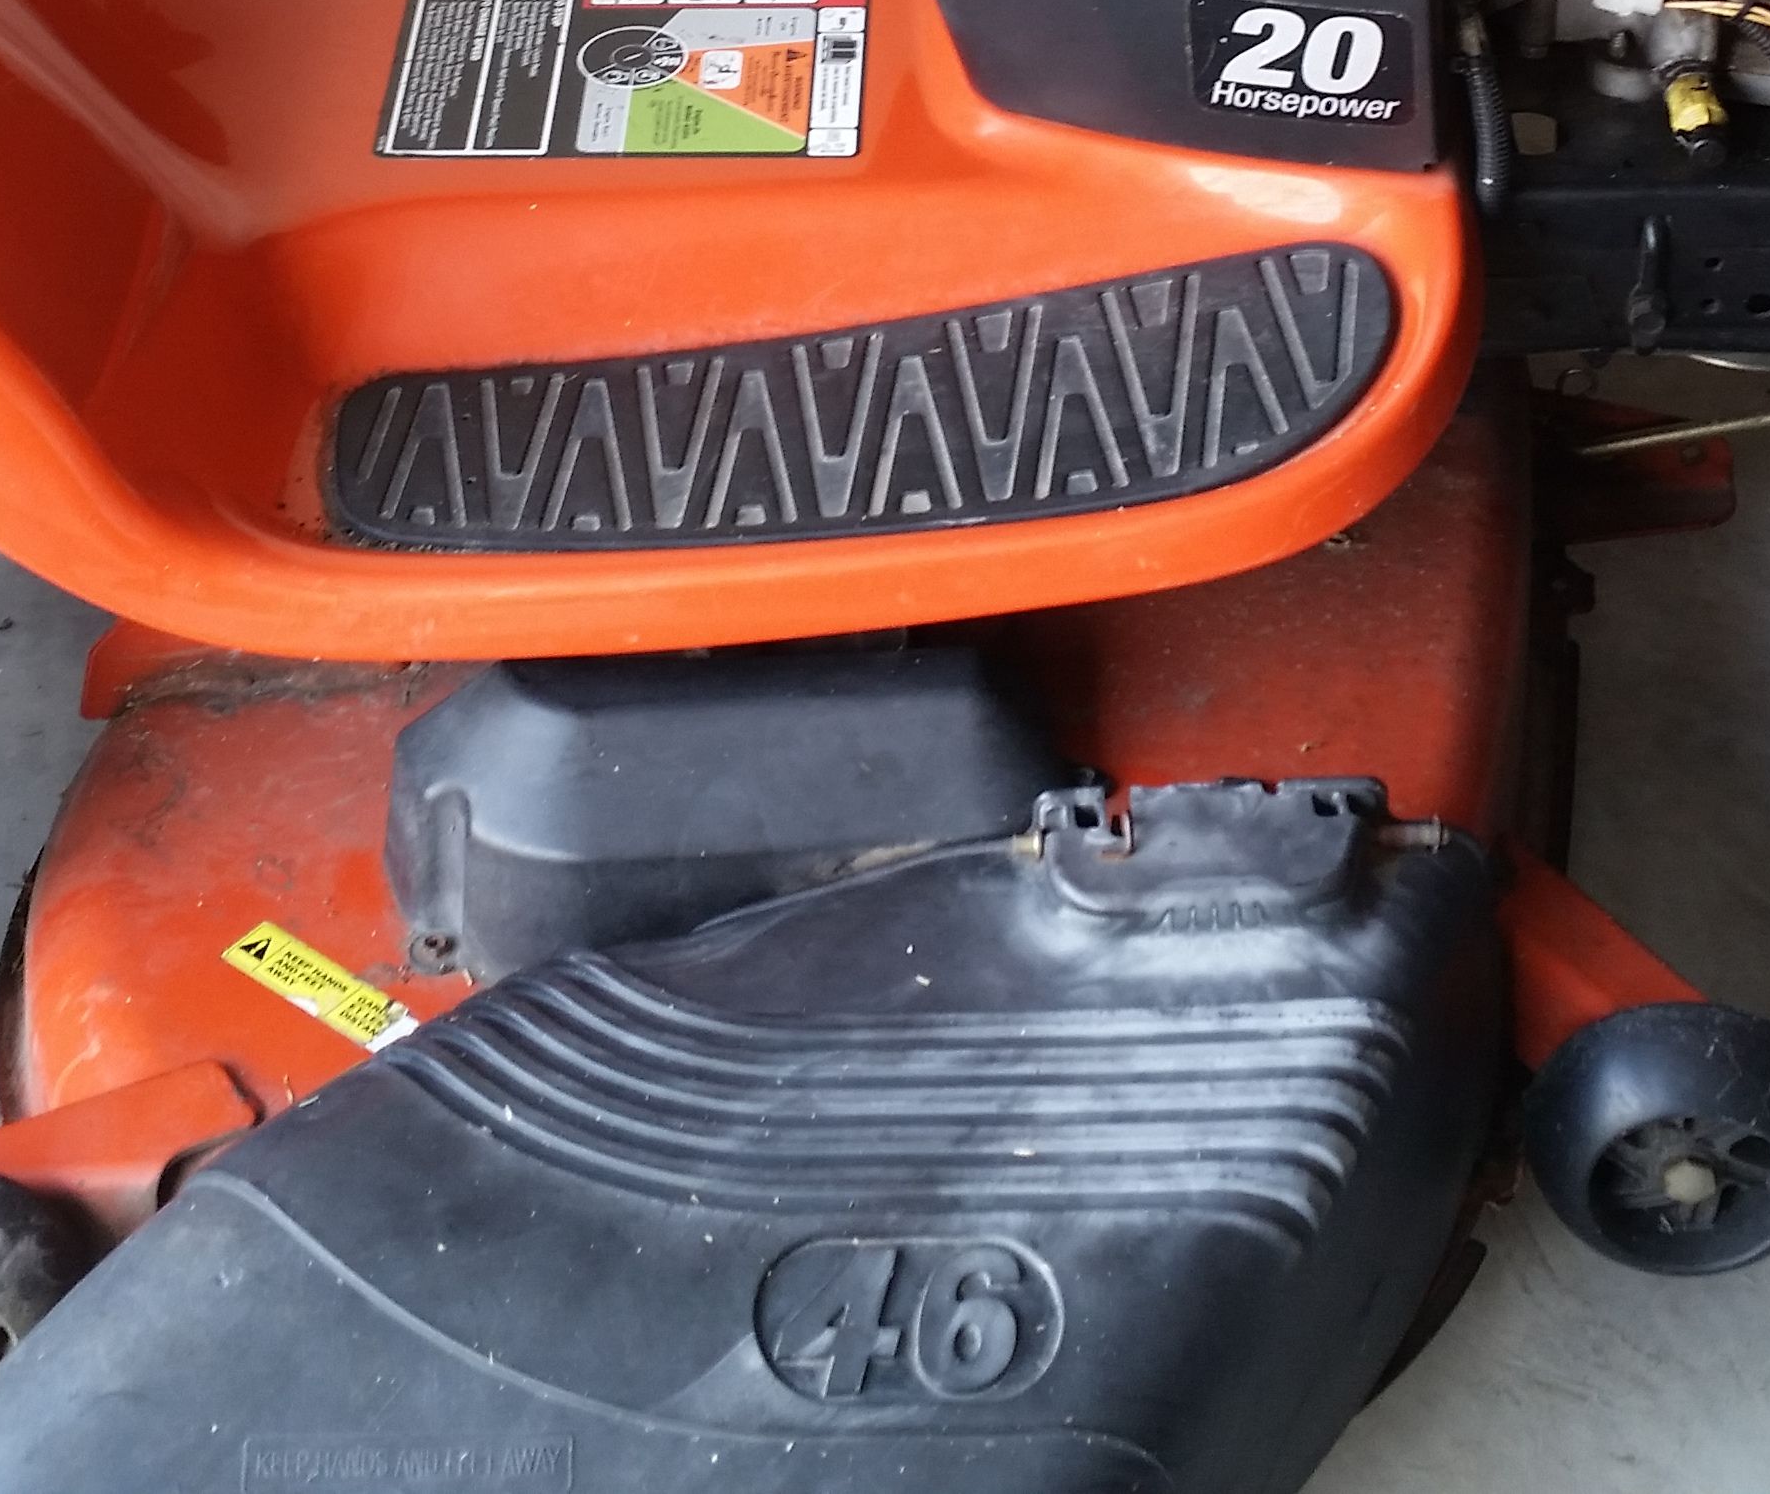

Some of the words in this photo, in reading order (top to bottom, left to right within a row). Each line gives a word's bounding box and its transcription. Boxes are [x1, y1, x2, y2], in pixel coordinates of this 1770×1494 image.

[1219, 7, 1384, 94] 20
[1210, 79, 1402, 120] Horsepower
[267, 965, 295, 986] AWAY
[275, 958, 299, 975] AND
[284, 950, 313, 969] KEEP
[311, 967, 349, 993] HANDS
[773, 1246, 1024, 1399] 46
